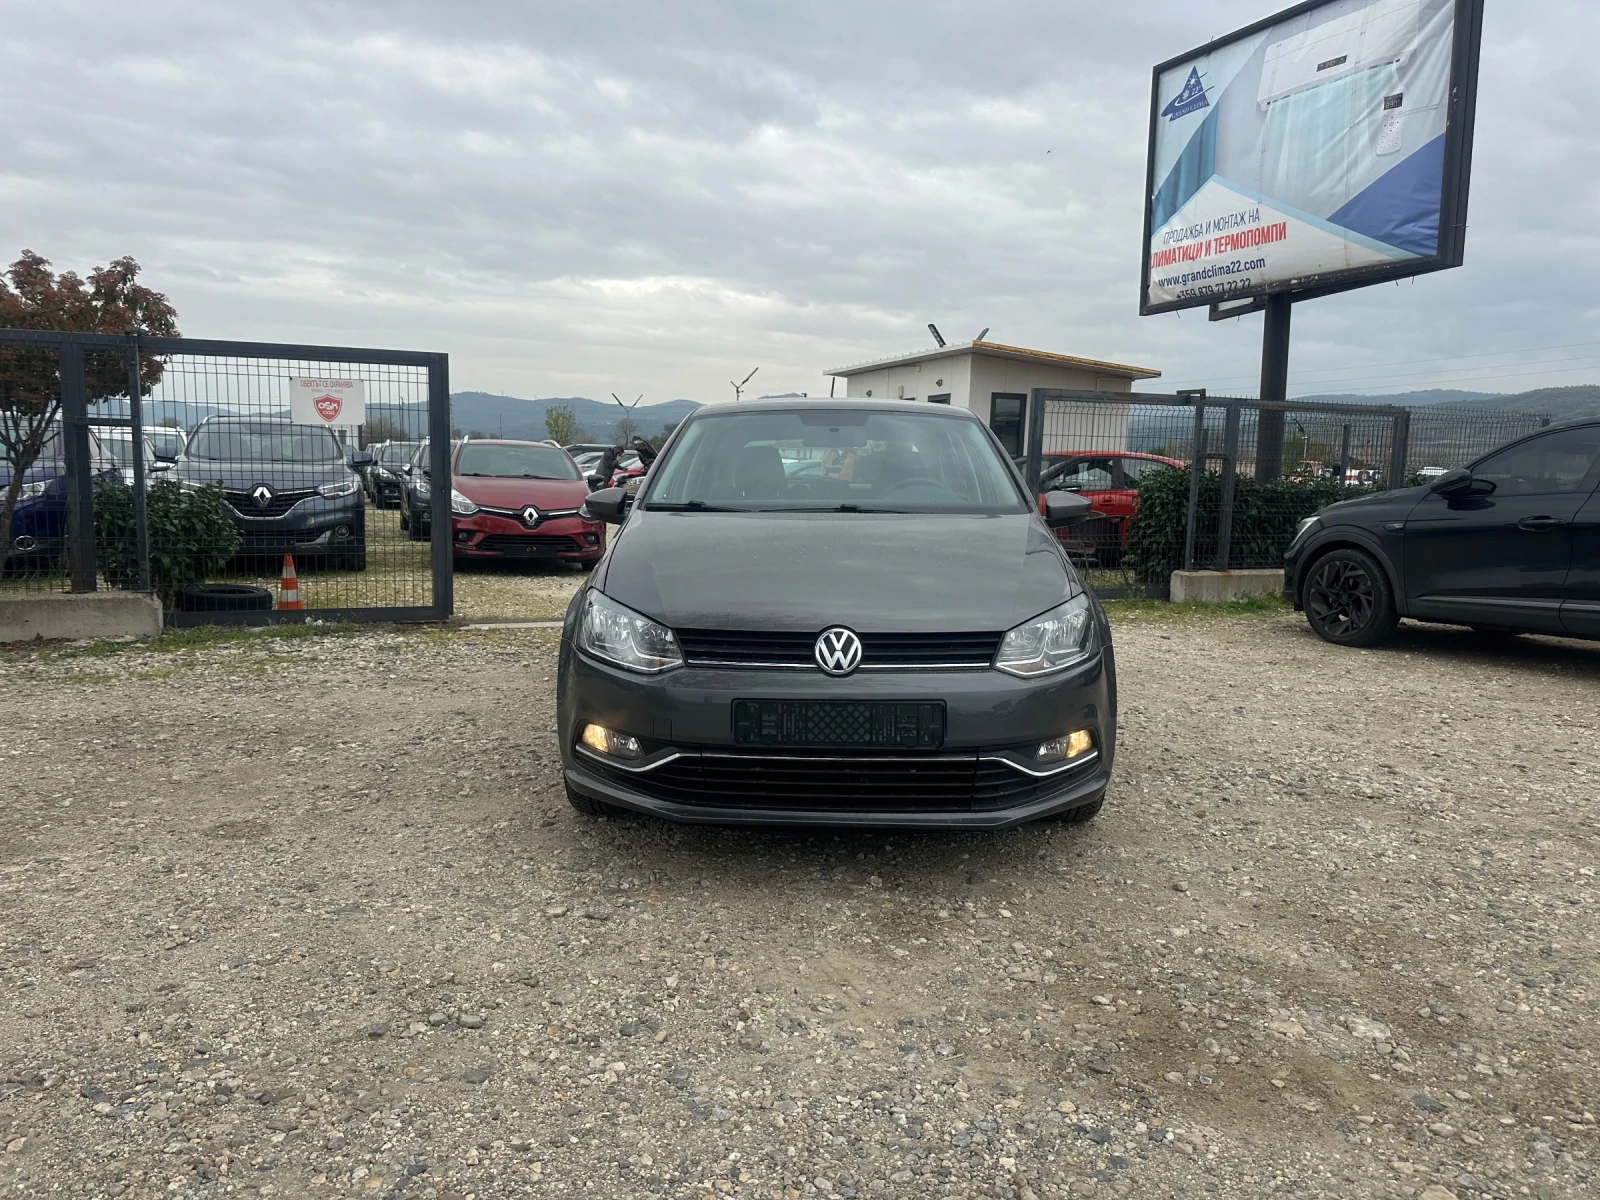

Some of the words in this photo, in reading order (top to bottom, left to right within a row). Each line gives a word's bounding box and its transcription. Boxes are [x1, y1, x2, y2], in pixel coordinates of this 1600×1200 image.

[1172, 107, 1189, 119] GRAND
[1190, 100, 1208, 111] CLIMA
[1163, 224, 1204, 245] ПРОДАЖБА
[1205, 223, 1211, 235] И
[1212, 211, 1247, 233] МОНТАЖ
[1248, 207, 1260, 224] НА
[1151, 241, 1203, 269] ЛИМАТИЦИ
[1204, 239, 1212, 257] И
[1213, 221, 1287, 255] ТЕРМОПОМПИ
[1158, 257, 1266, 287] www.grandclima22.com
[1176, 289, 1197, 300] +359
[1198, 285, 1215, 297] 879
[322, 380, 329, 388] СЕ
[815, 628, 862, 674] VW
